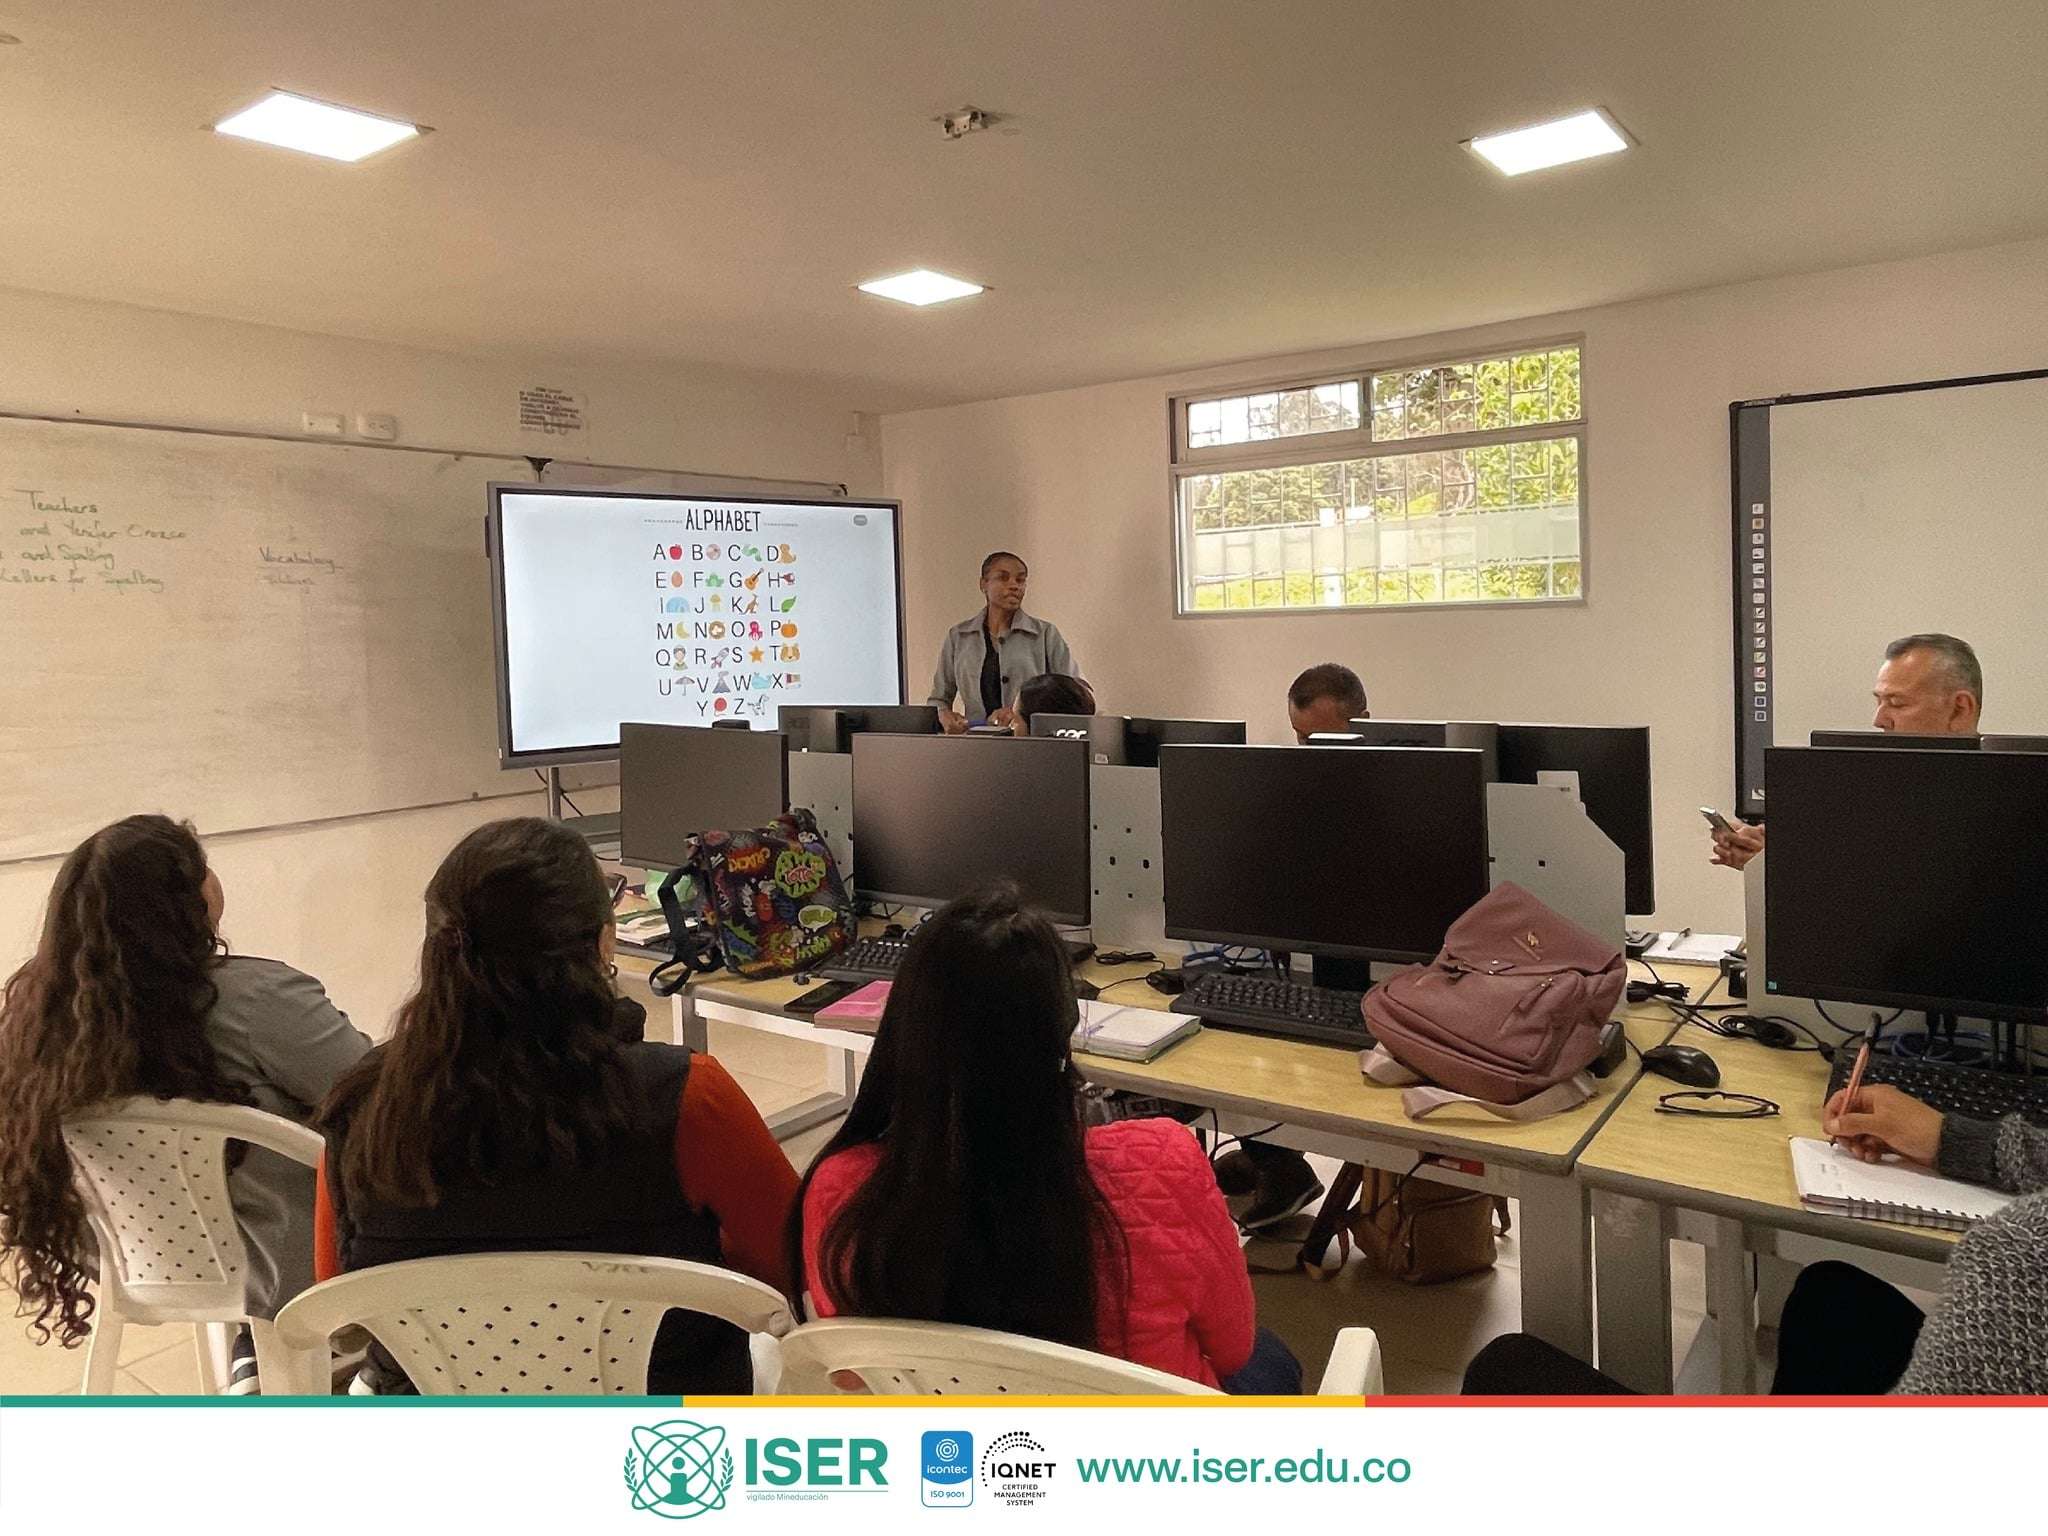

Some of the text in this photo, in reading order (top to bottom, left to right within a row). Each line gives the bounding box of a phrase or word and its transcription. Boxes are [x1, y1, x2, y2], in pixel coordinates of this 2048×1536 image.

[686, 509, 760, 531] ALPHABET
[654, 544, 778, 561] A B C D
[656, 572, 781, 588] E F G H
[695, 597, 704, 613] J
[732, 597, 742, 612] K
[770, 596, 779, 611] L
[658, 620, 782, 639] M N O P
[656, 646, 780, 666] Q R S T
[660, 674, 783, 695] U V W X
[697, 698, 744, 716] Y Z
